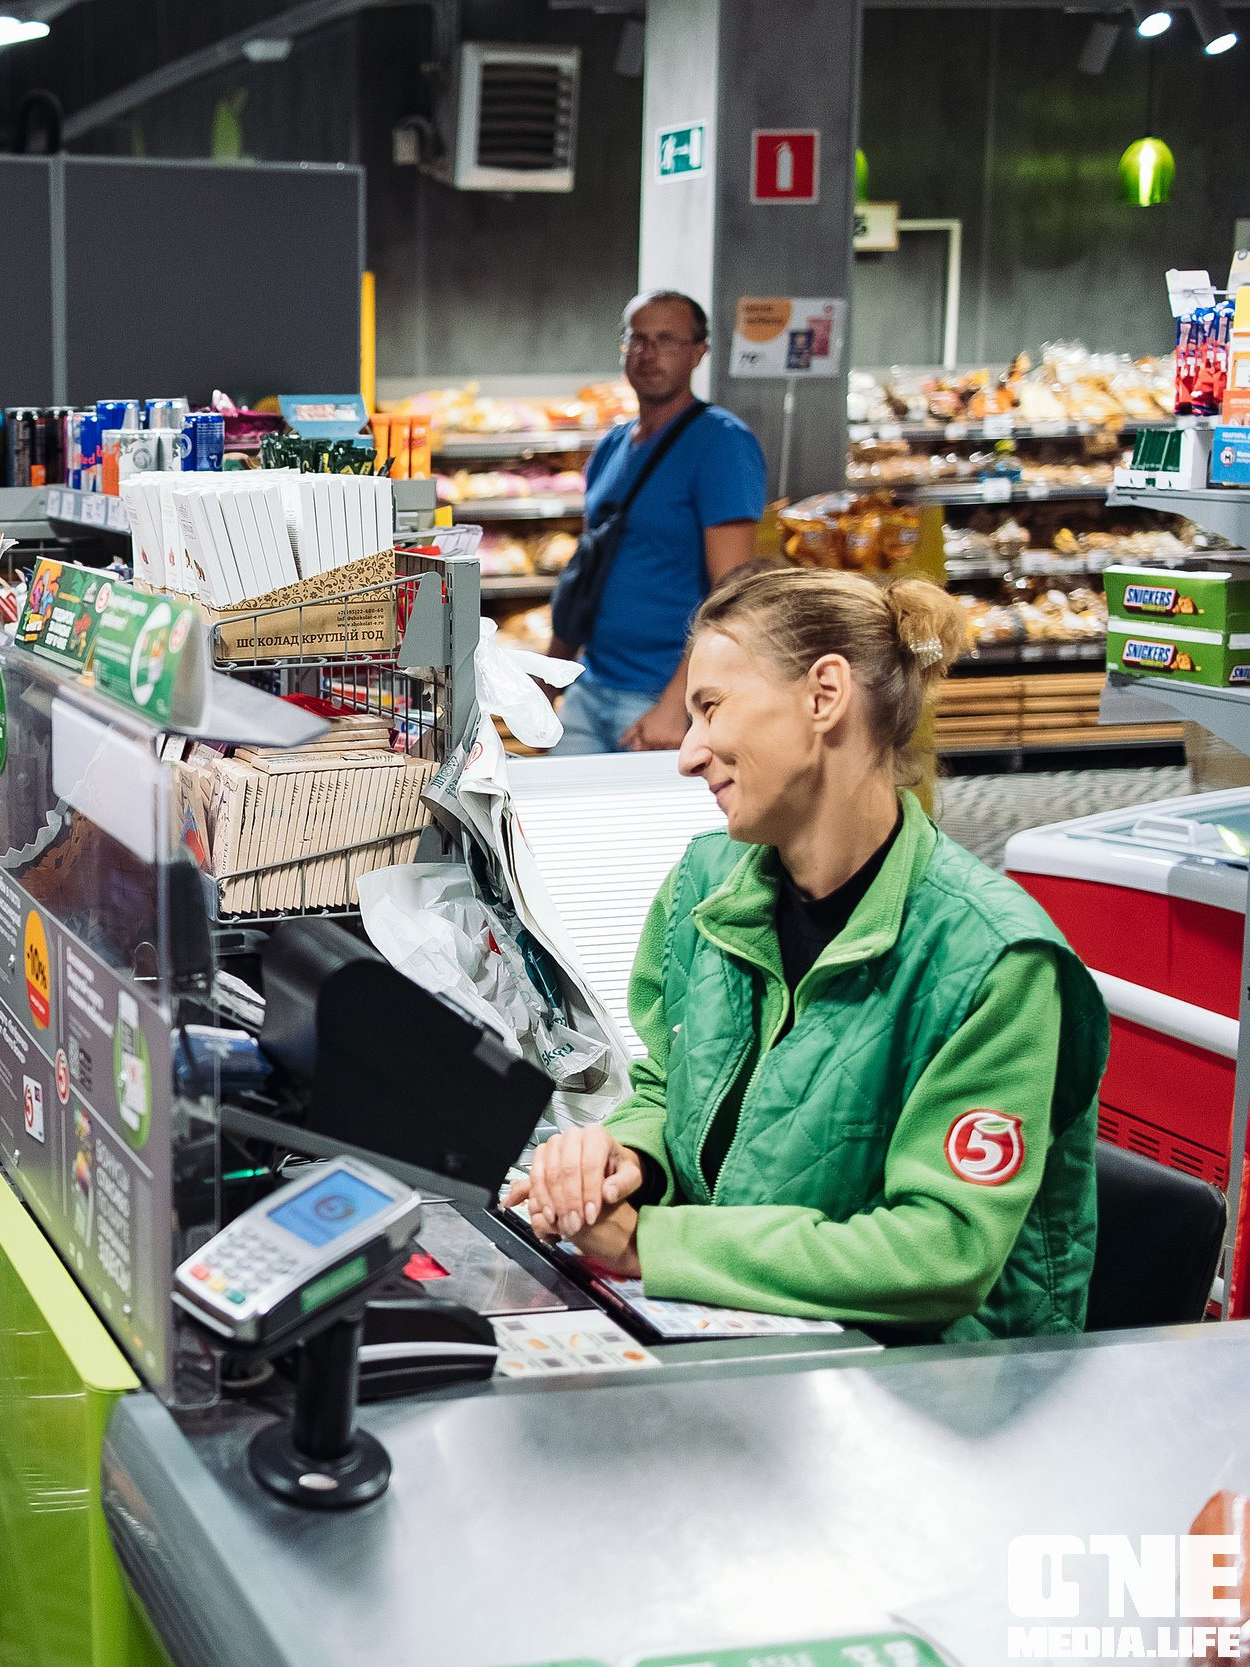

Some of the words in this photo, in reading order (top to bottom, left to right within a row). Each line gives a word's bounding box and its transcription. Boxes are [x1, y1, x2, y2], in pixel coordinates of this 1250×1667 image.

[1126, 588, 1173, 607] SNICKERS
[236, 635, 300, 648] ШОКОЛАД
[302, 629, 359, 644] КРУГЛЫЙ
[362, 629, 384, 641] ГОД
[1125, 643, 1171, 662] SNICKERS
